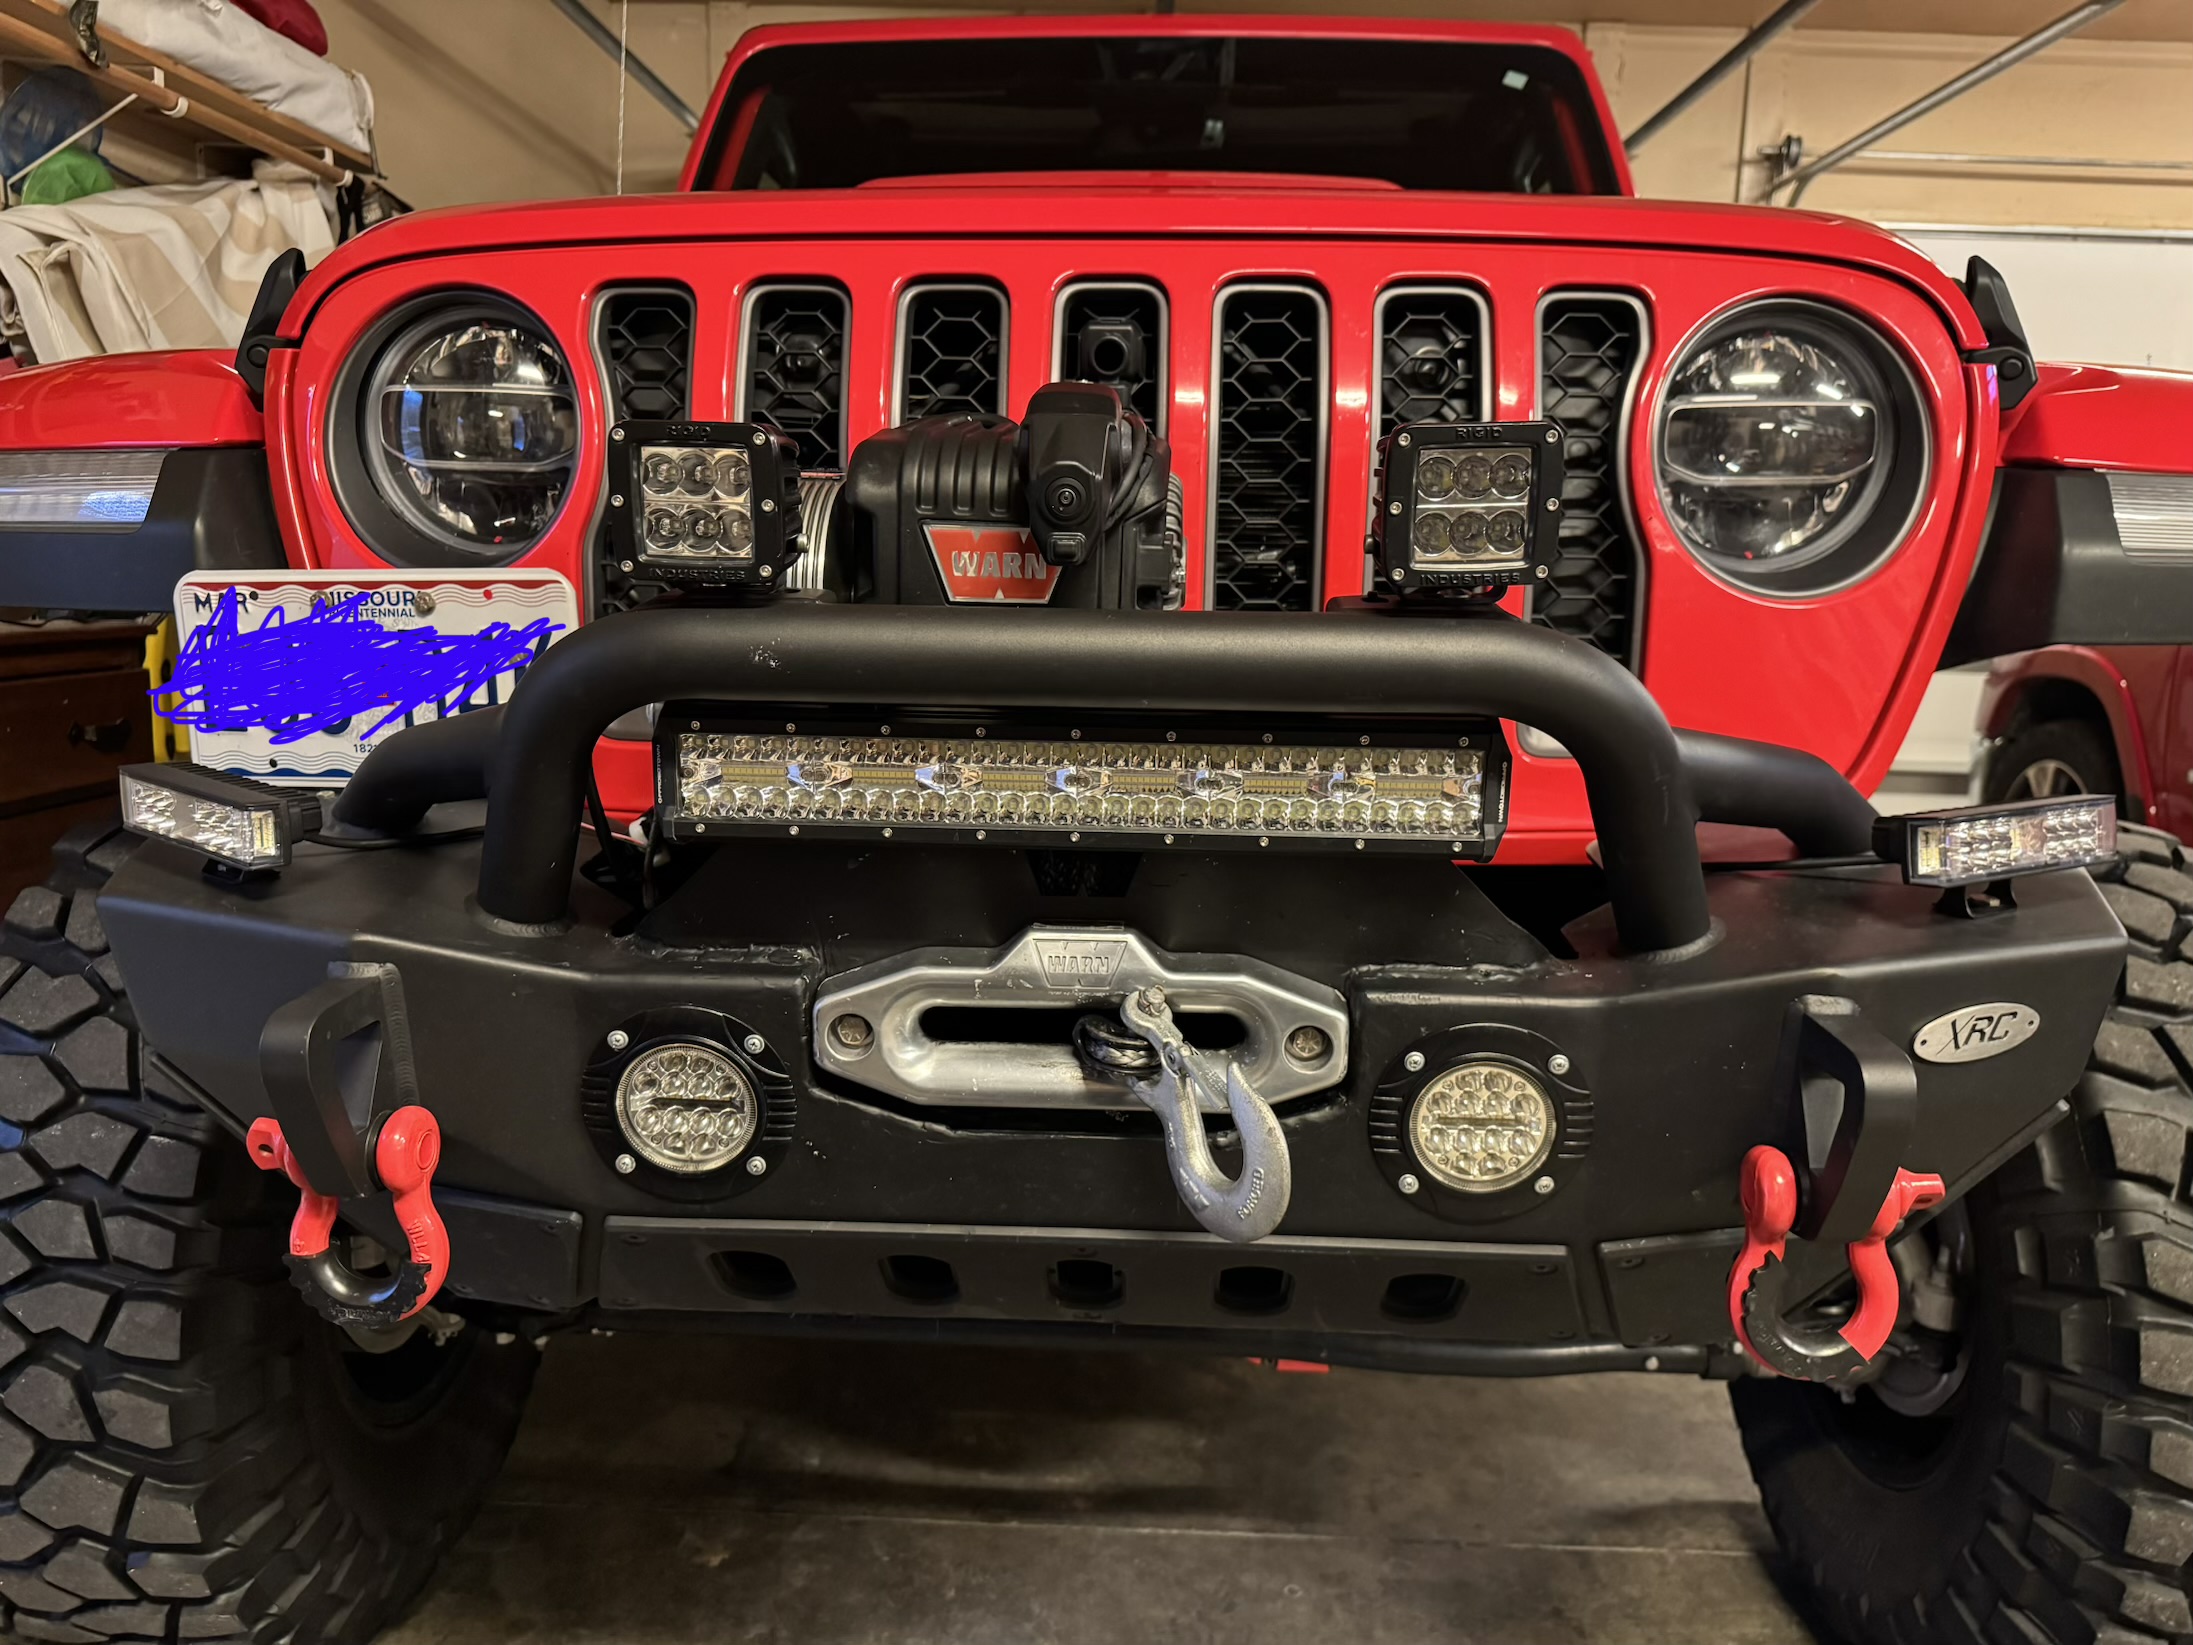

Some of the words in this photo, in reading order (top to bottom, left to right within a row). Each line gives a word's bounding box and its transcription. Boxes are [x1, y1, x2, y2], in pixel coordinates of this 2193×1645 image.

[1455, 427, 1503, 439] RIGID
[951, 550, 1047, 580] WARN
[649, 567, 746, 581] INDUSTRIES
[1420, 571, 1521, 585] INDUSTRIES
[328, 590, 421, 606] ISOUR
[1048, 955, 1110, 974] WARN
[1936, 1011, 2018, 1056] XRC
